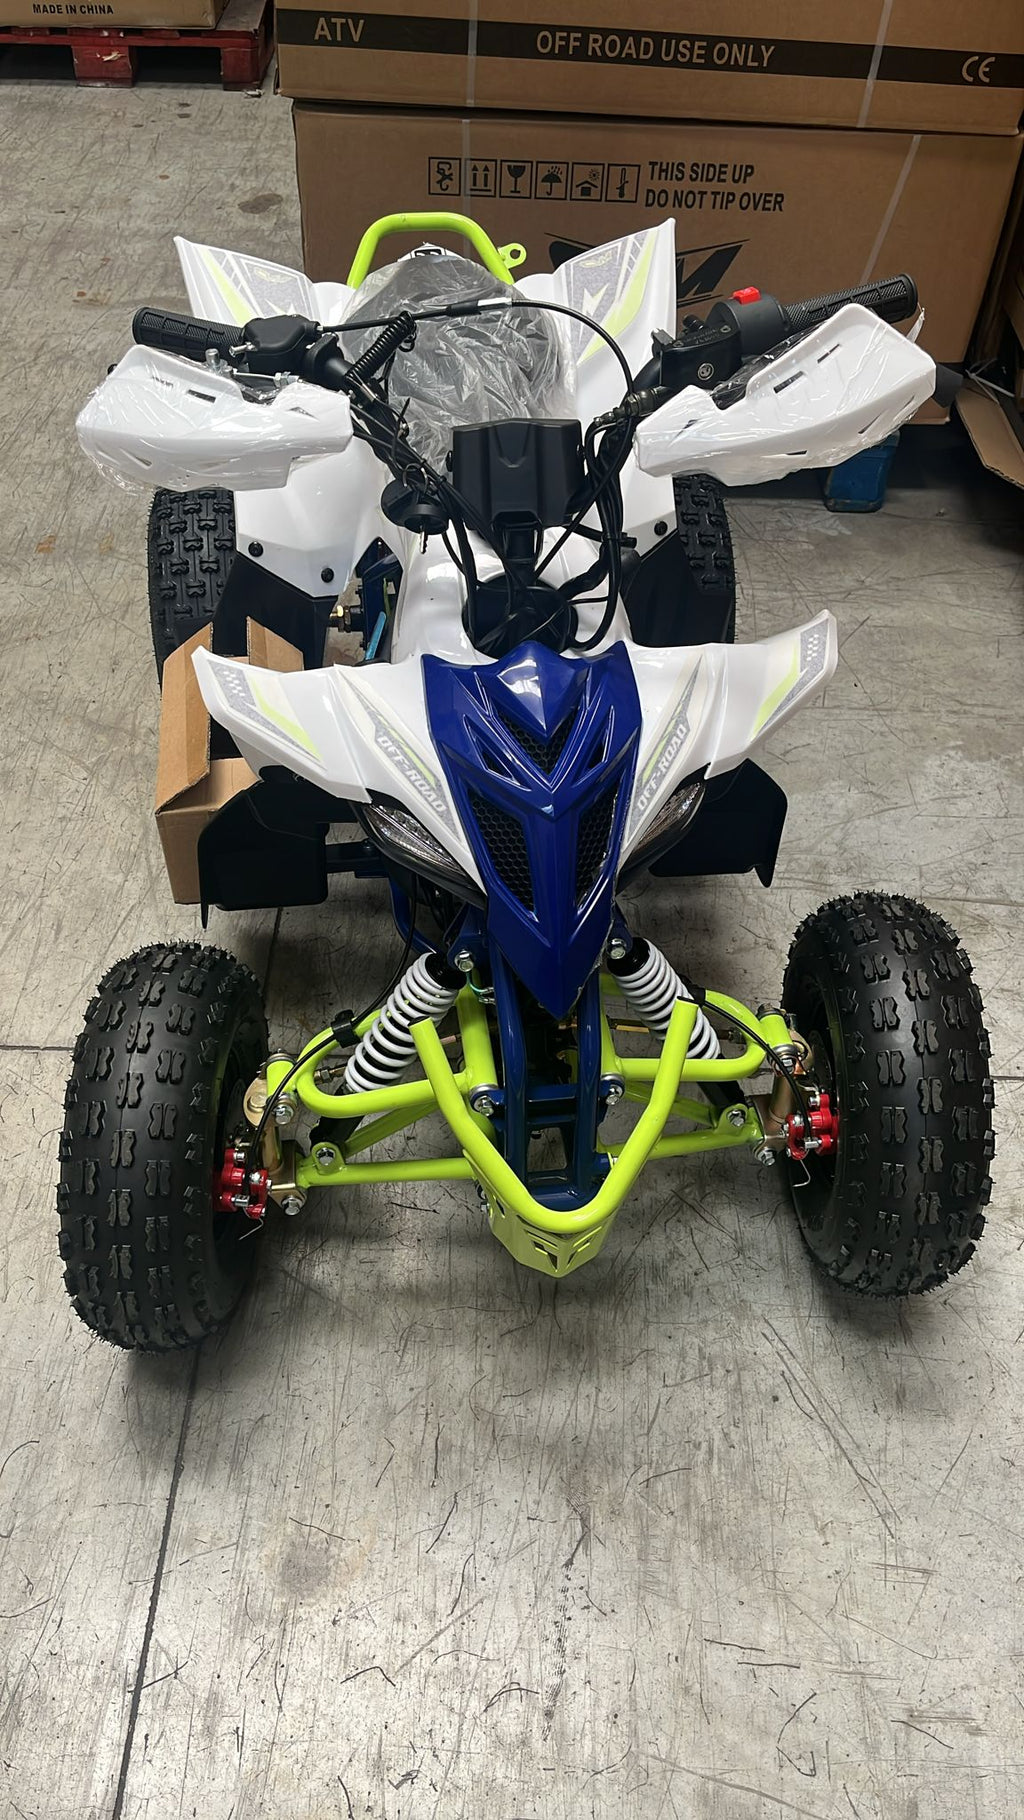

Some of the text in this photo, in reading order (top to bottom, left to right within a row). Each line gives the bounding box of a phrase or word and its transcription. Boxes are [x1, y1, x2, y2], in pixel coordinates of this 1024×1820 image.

[32, 4, 114, 15] MADE IN CHINA
[314, 17, 365, 42] ATV
[536, 31, 775, 67] OFF ROAD USE ONLY
[962, 56, 996, 83] CE
[648, 161, 754, 184] THIS SIDE UP
[645, 188, 785, 211] DO NOT TIP OVER
[377, 736, 448, 812] OFF-ROAD
[637, 723, 688, 810] OFF-ROAD
